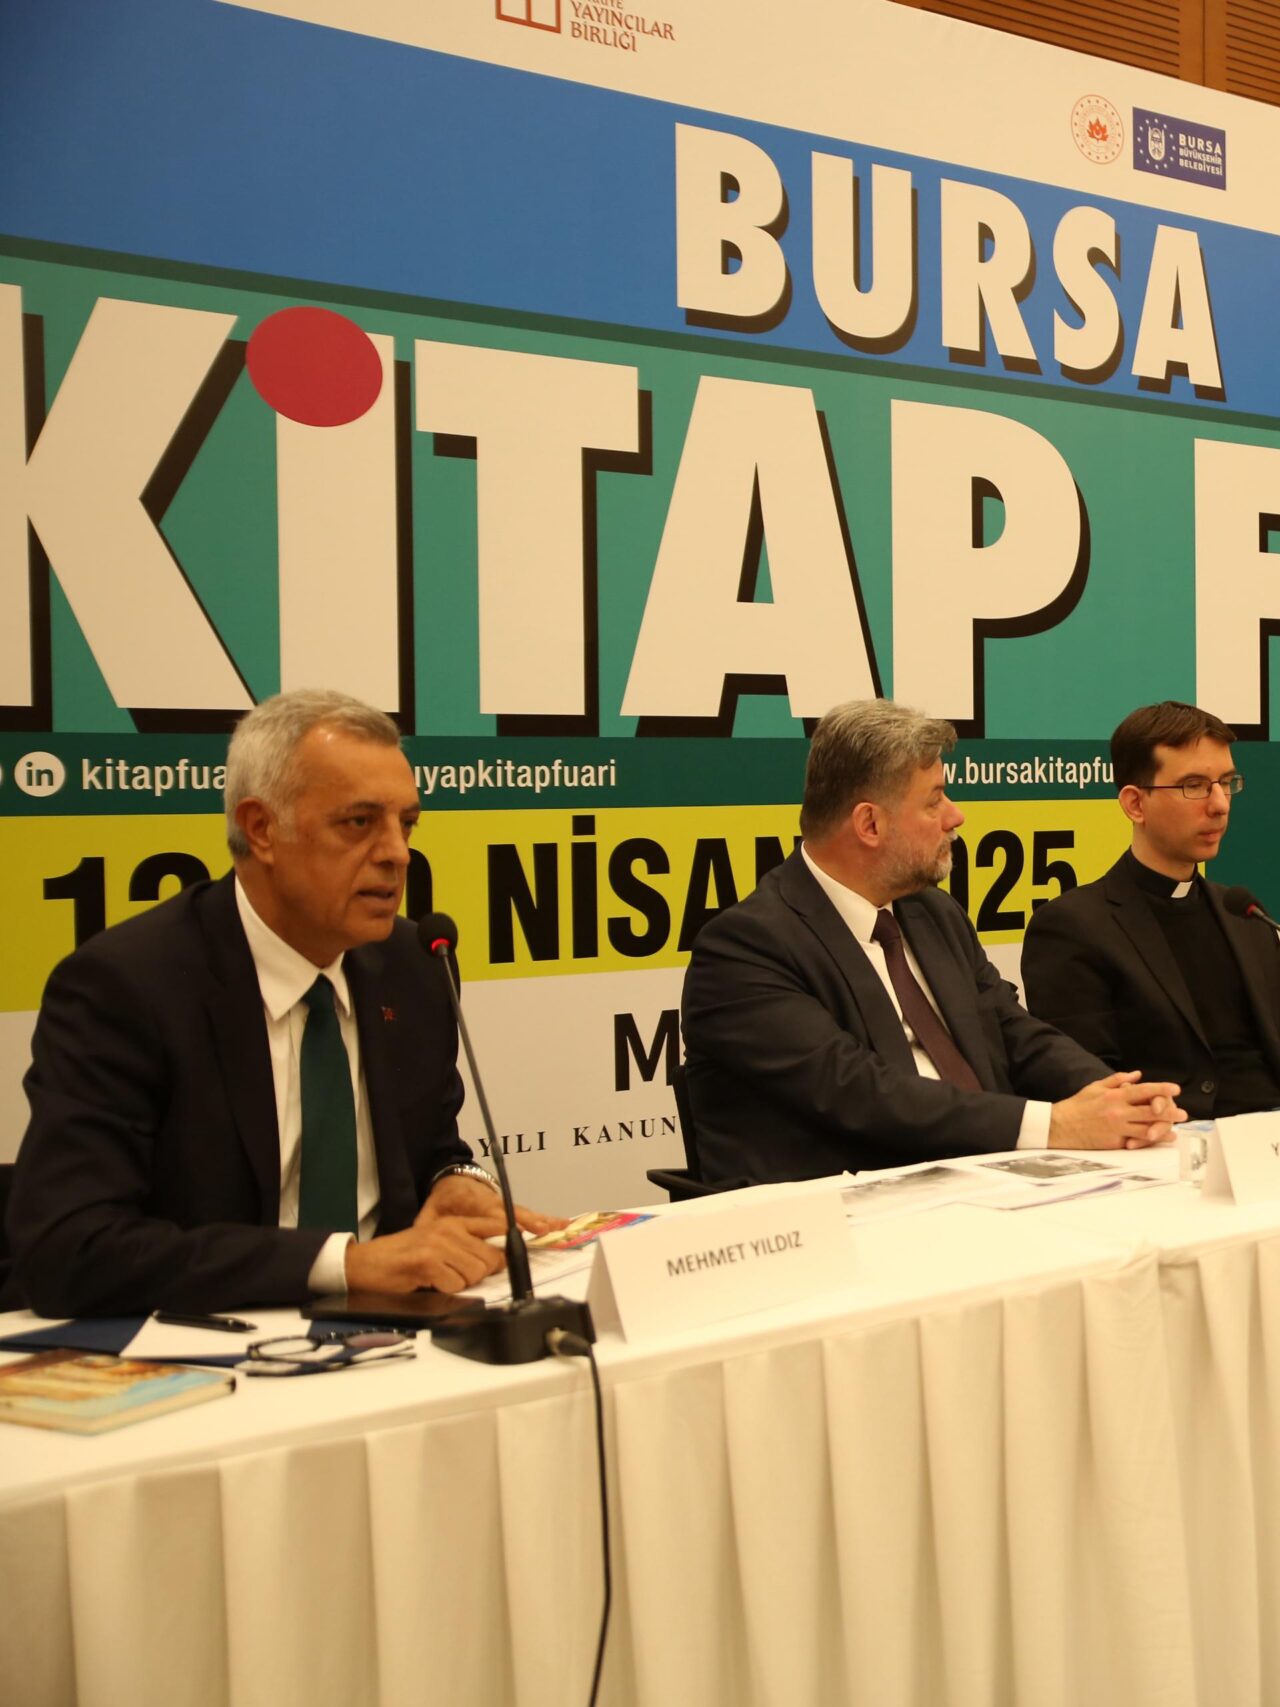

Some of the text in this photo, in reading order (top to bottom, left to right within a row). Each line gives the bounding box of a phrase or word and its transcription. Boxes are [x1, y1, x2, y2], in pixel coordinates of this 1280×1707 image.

[570, 0, 676, 41] YAYINCILAR
[570, 21, 638, 52] BİRLİĞİ
[1178, 133, 1223, 155] BURSA
[1178, 147, 1222, 165] BÜYÜKŞEHİR
[1178, 158, 1223, 176] BELEDİYESİ
[676, 122, 1223, 391] BURSA
[0, 283, 1081, 723] KİTAP
[82, 758, 227, 796] kitapfua
[414, 759, 617, 795] yapkitapfuari
[942, 756, 1115, 790] w.bursakitapfu
[487, 815, 803, 964] NİSA
[950, 829, 1078, 932] 25
[478, 1131, 547, 1158] YILI
[666, 1230, 803, 1278] MEHMET YILDIZ
